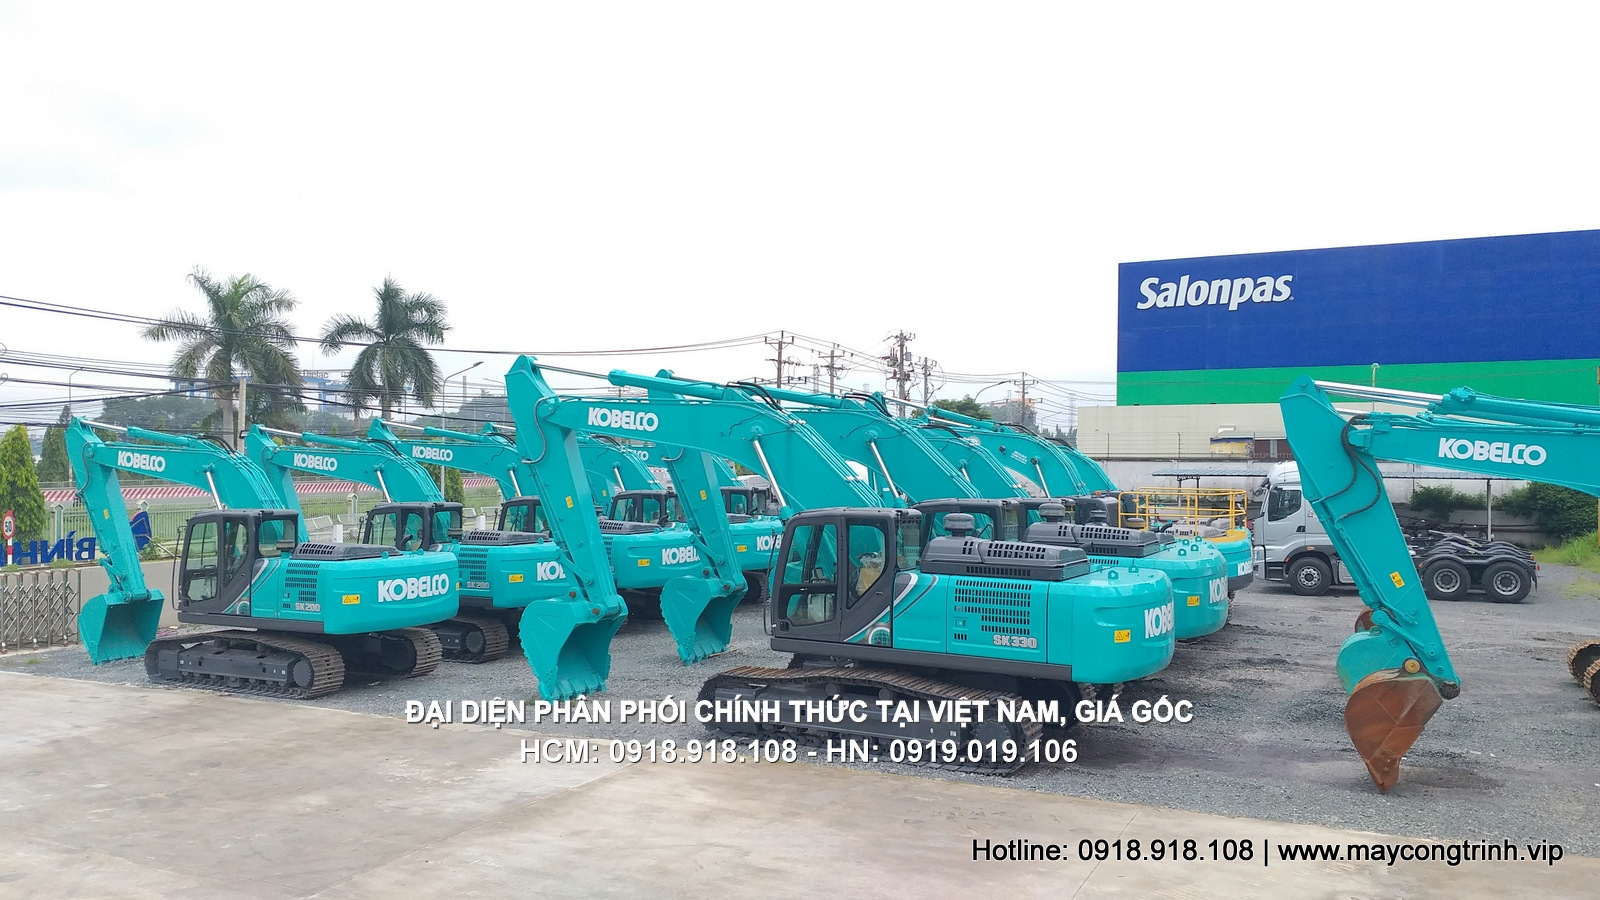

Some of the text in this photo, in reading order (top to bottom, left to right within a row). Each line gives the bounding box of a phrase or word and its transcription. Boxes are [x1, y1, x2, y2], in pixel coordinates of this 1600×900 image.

[1136, 274, 1294, 311] Salonpas
[587, 406, 660, 432] KOBELCO
[117, 450, 167, 473] KOBELCO
[293, 453, 338, 472] KOBELCO
[412, 445, 454, 462] KOBELCO
[1438, 437, 1547, 466] KOBELCO
[4, 520, 12, 533] 50
[661, 545, 701, 566] KOBEL
[377, 573, 450, 603] KOBELCO
[1144, 600, 1174, 639] KOBE
[993, 634, 1038, 649] SK330
